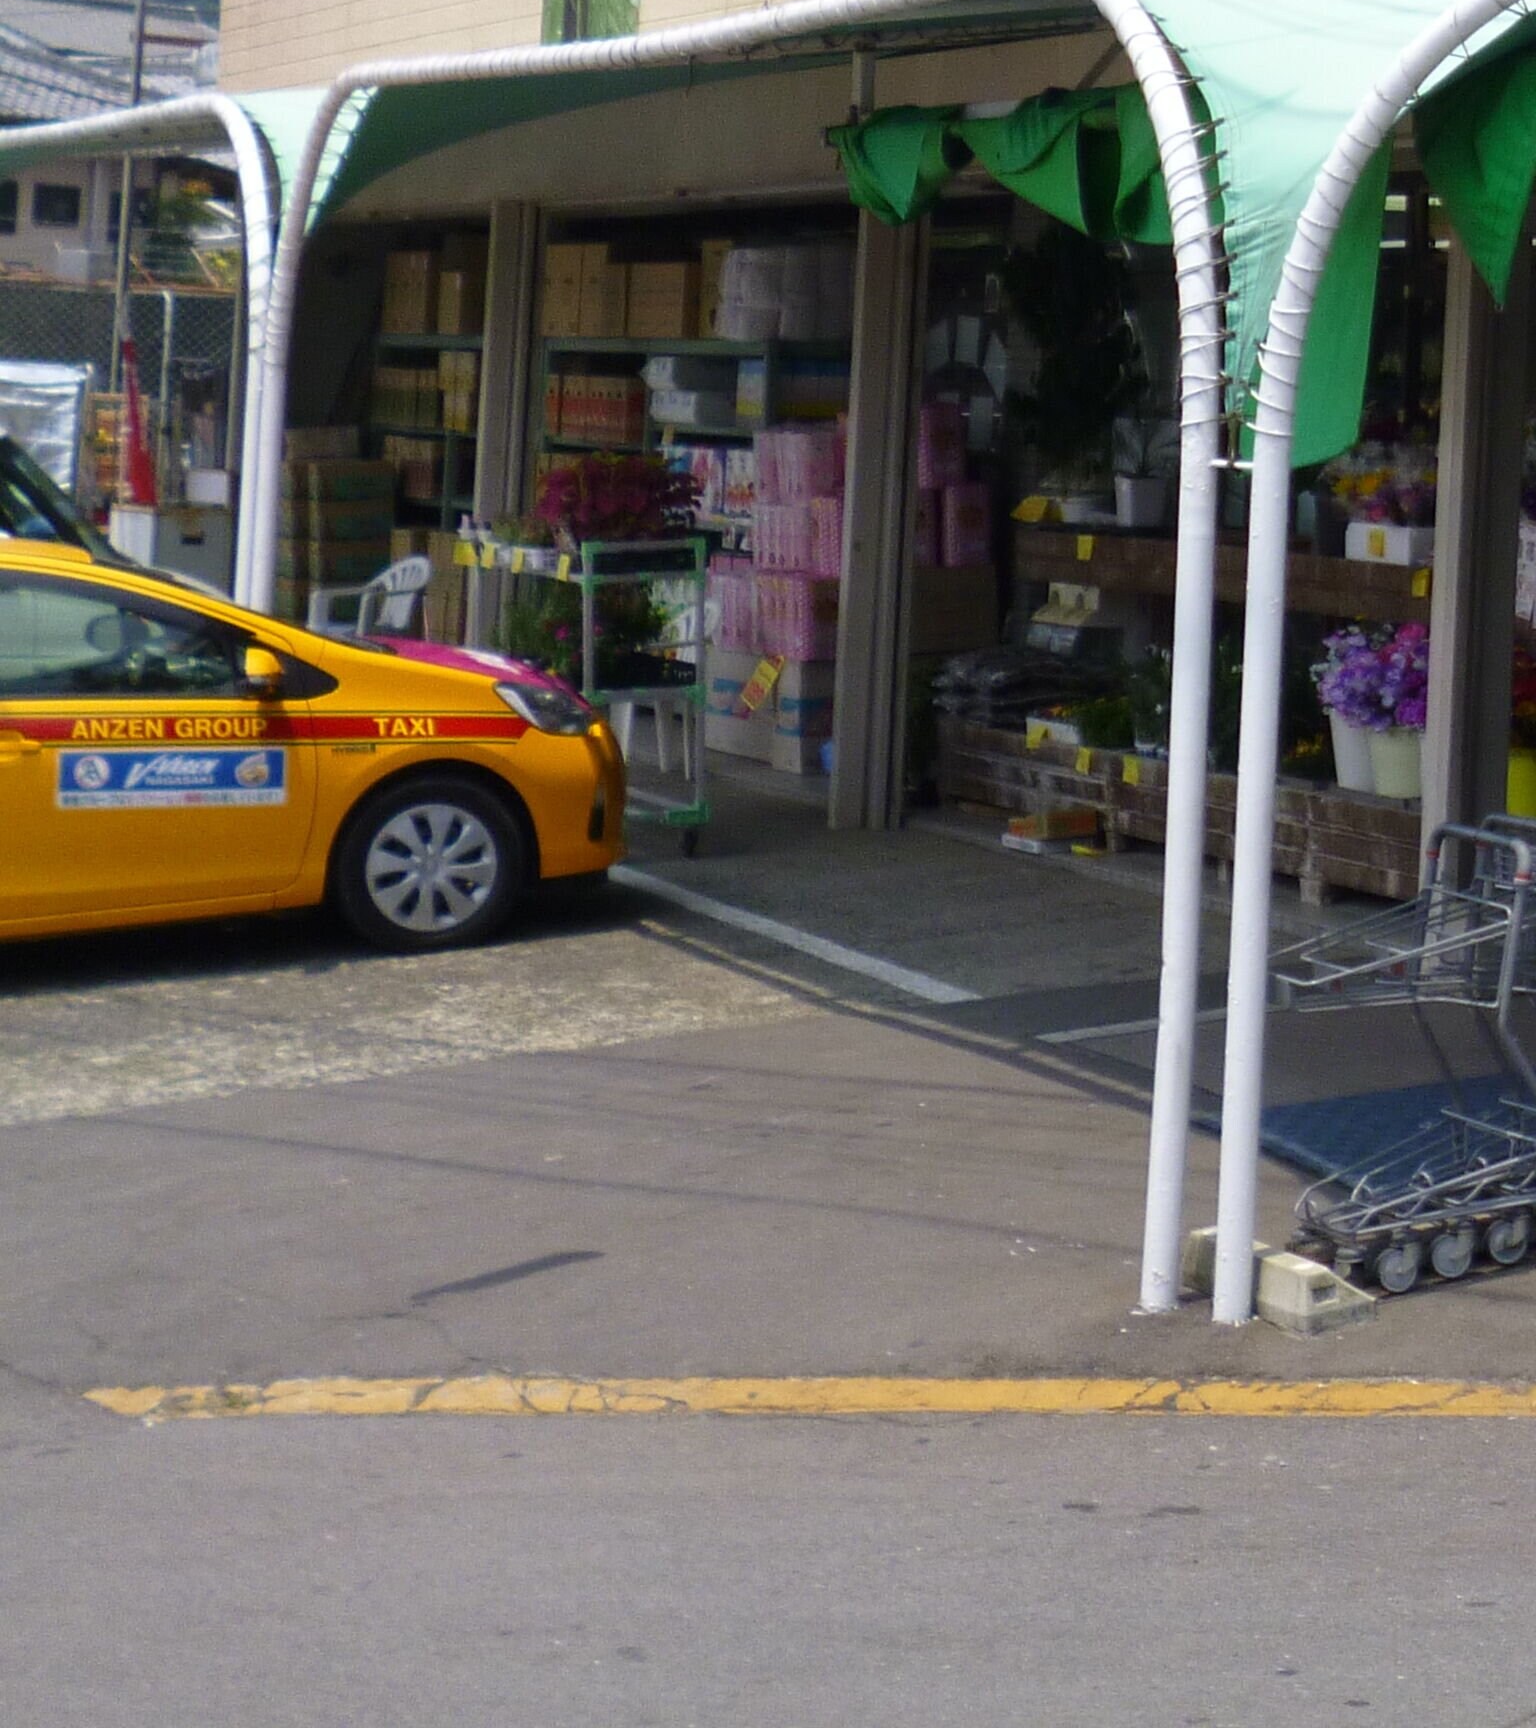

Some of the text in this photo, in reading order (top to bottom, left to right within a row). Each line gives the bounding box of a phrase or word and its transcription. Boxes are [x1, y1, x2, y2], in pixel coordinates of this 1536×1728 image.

[71, 716, 436, 740] ANZEN GROUP TAXI
